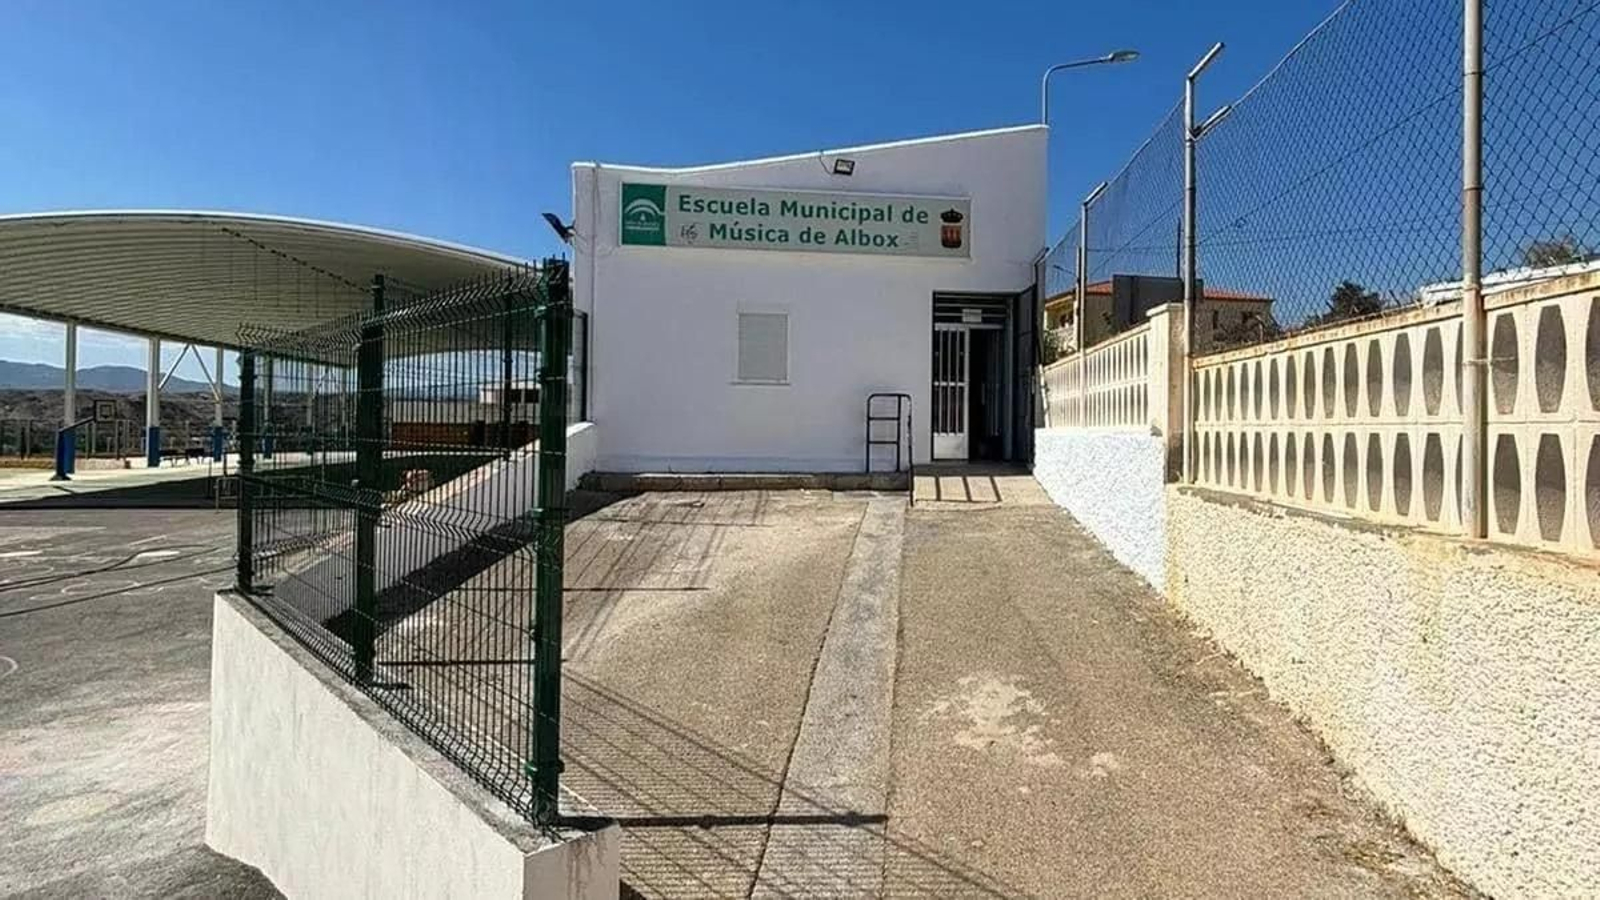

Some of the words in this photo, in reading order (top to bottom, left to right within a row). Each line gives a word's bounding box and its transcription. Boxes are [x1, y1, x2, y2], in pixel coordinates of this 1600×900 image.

[679, 194, 770, 216] Escuela
[780, 200, 893, 225] Municipal
[902, 206, 929, 224] de
[709, 221, 789, 243] Música
[799, 226, 826, 245] de
[834, 228, 899, 248] Albox
